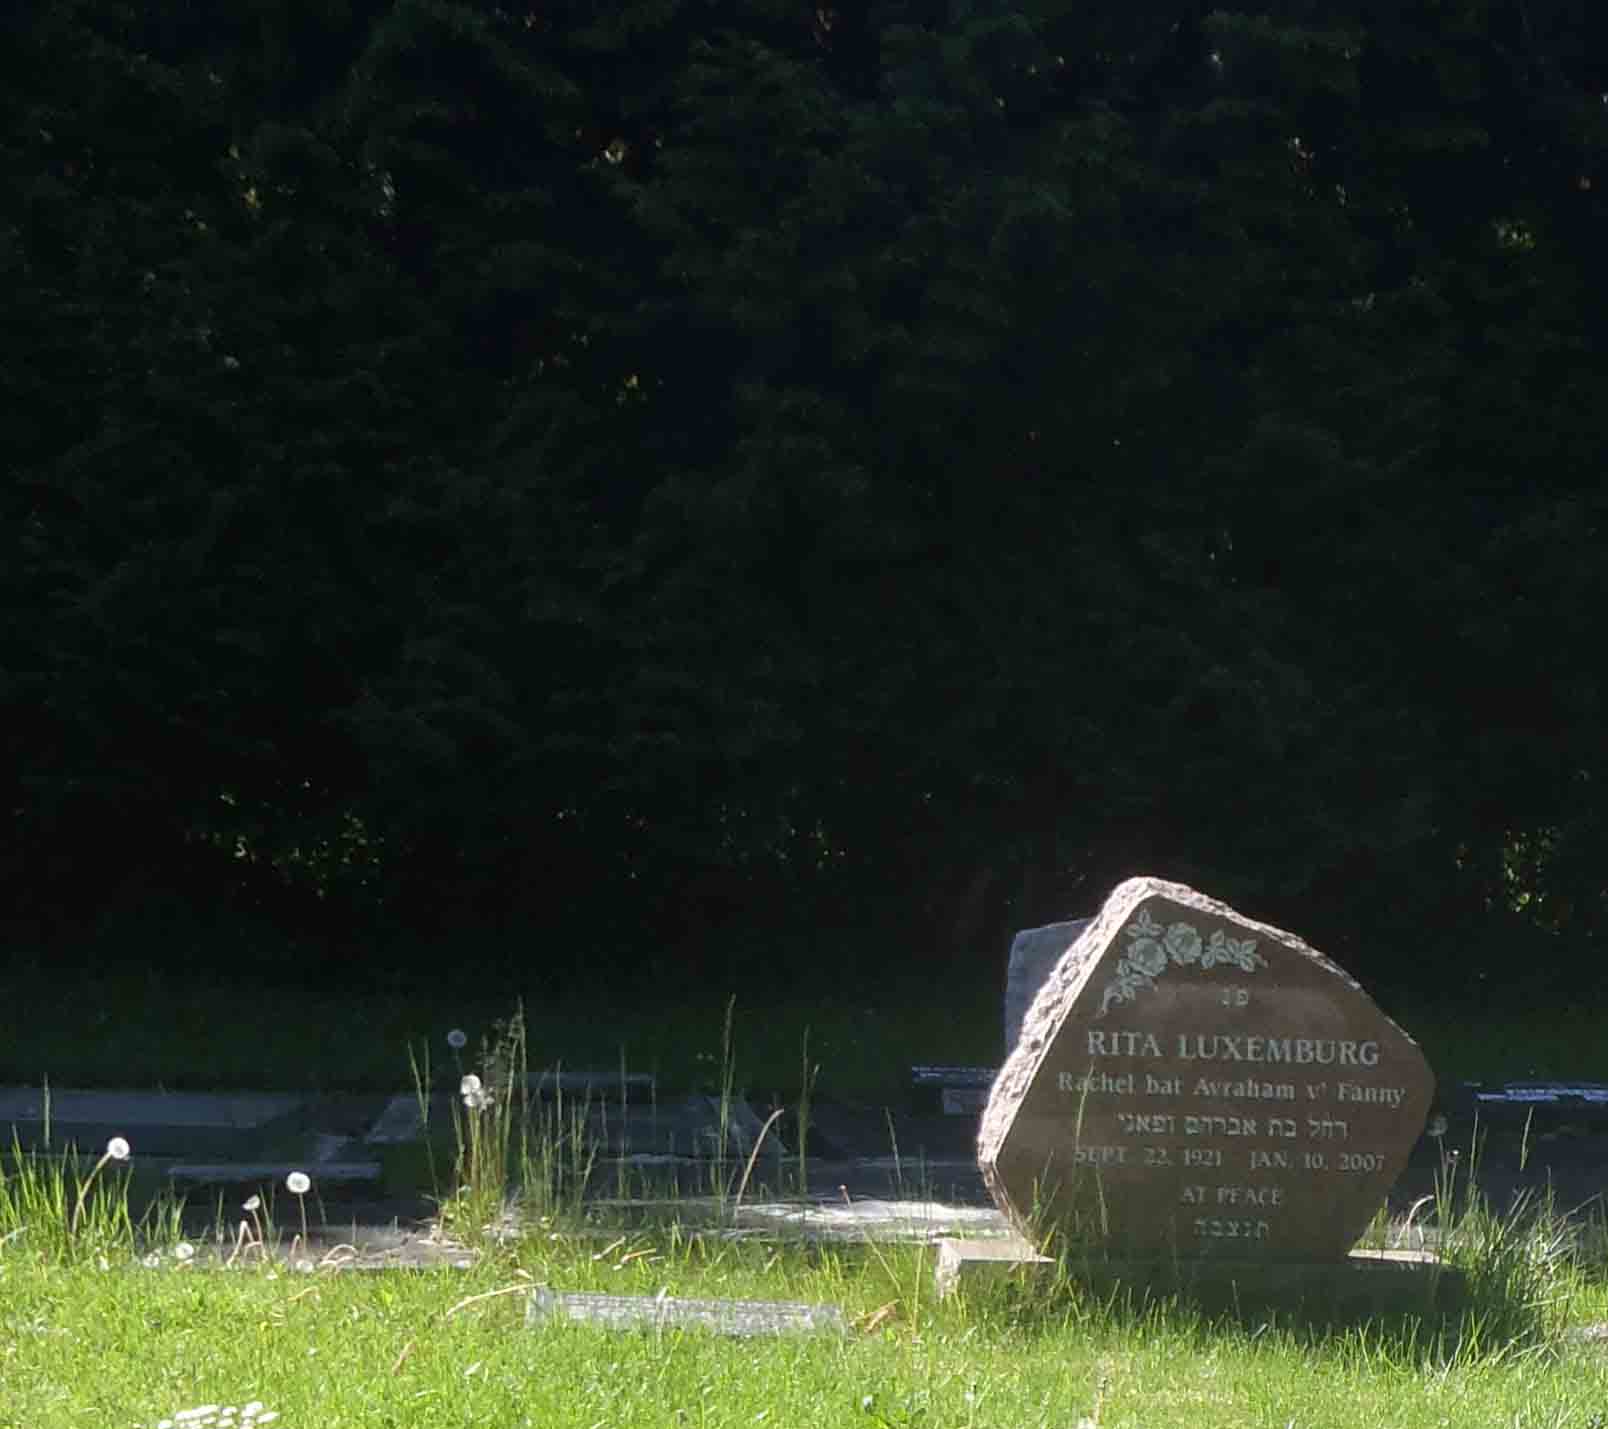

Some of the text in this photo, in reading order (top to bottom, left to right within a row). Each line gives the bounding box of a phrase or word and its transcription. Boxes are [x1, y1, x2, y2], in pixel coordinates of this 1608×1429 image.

[1088, 1031, 1379, 1065] RITA LUXEMBURG
[1057, 1071, 1135, 1094] Rachel
[1145, 1074, 1183, 1096] bat
[1193, 1077, 1295, 1099] Avraham
[1337, 1082, 1406, 1108] Fanny
[1183, 1149, 1223, 1167] 1921
[1338, 1153, 1386, 1173] 2007
[1182, 1186, 1284, 1208] AT PEACE
